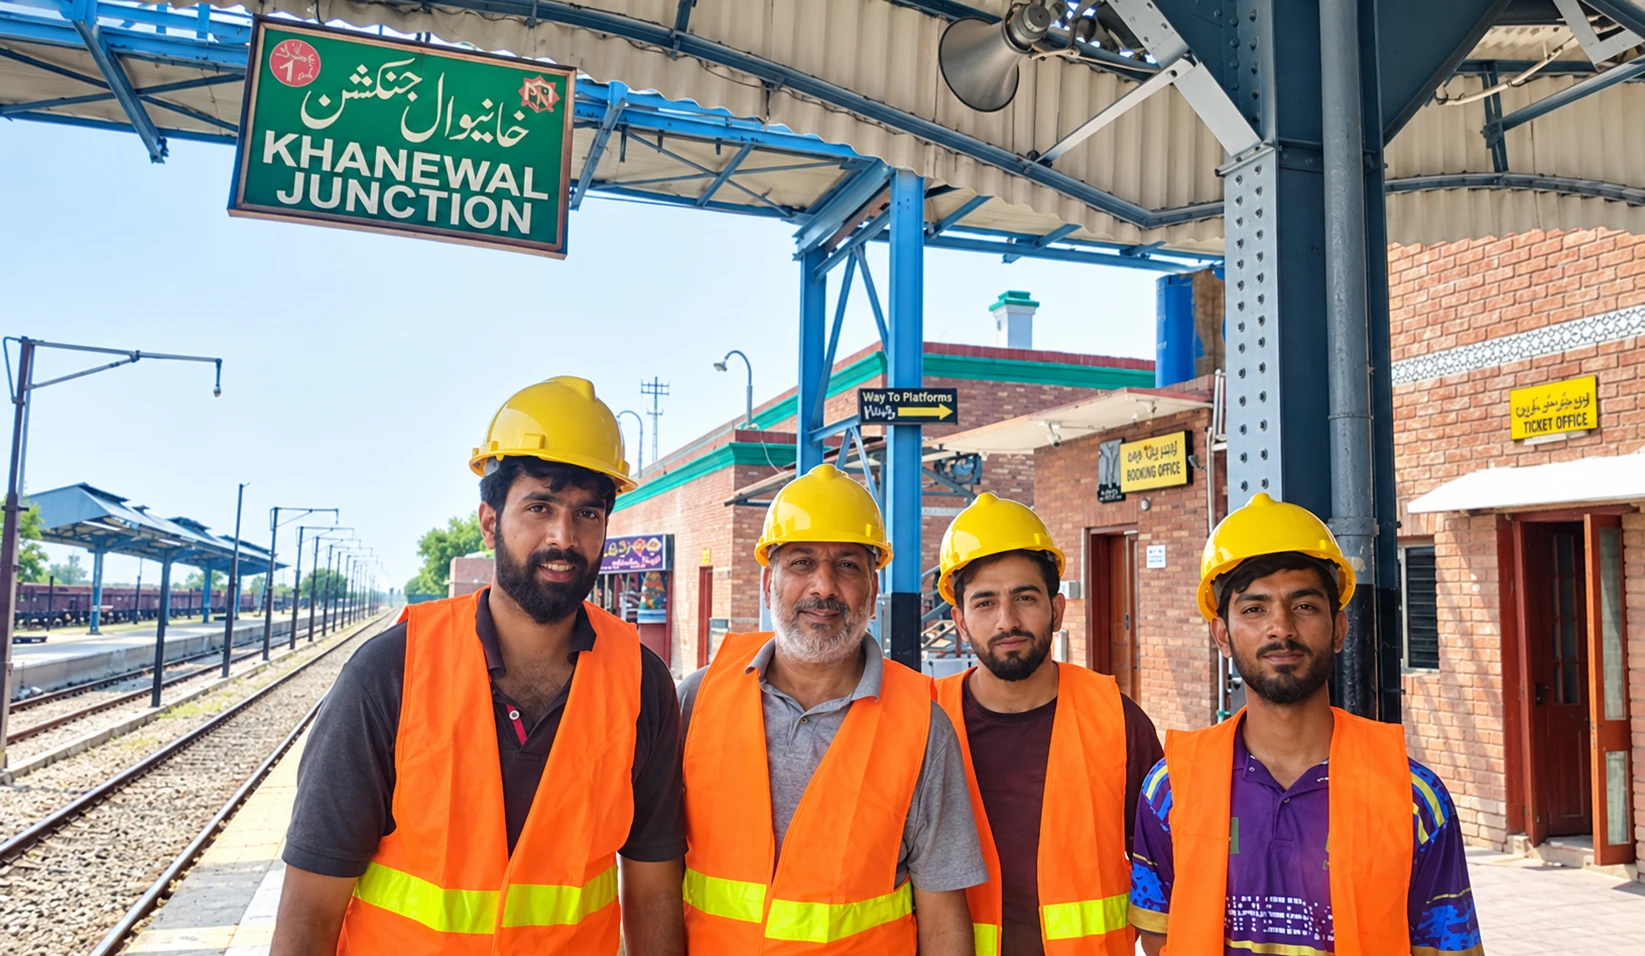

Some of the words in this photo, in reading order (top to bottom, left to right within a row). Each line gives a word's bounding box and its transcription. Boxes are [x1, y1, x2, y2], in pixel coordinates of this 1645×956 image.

[300, 57, 423, 129] جنکشن
[401, 71, 530, 148] خانیوال
[262, 129, 549, 201] KHANEWAL
[275, 171, 533, 235] JUNCTION
[862, 391, 886, 405] Way
[887, 391, 901, 402] To
[902, 391, 953, 403] Platforms
[1523, 417, 1553, 434] TICKET
[1555, 412, 1589, 430] OFFICE
[1126, 465, 1157, 482] BOOKING
[1157, 461, 1181, 477] OFFICE
